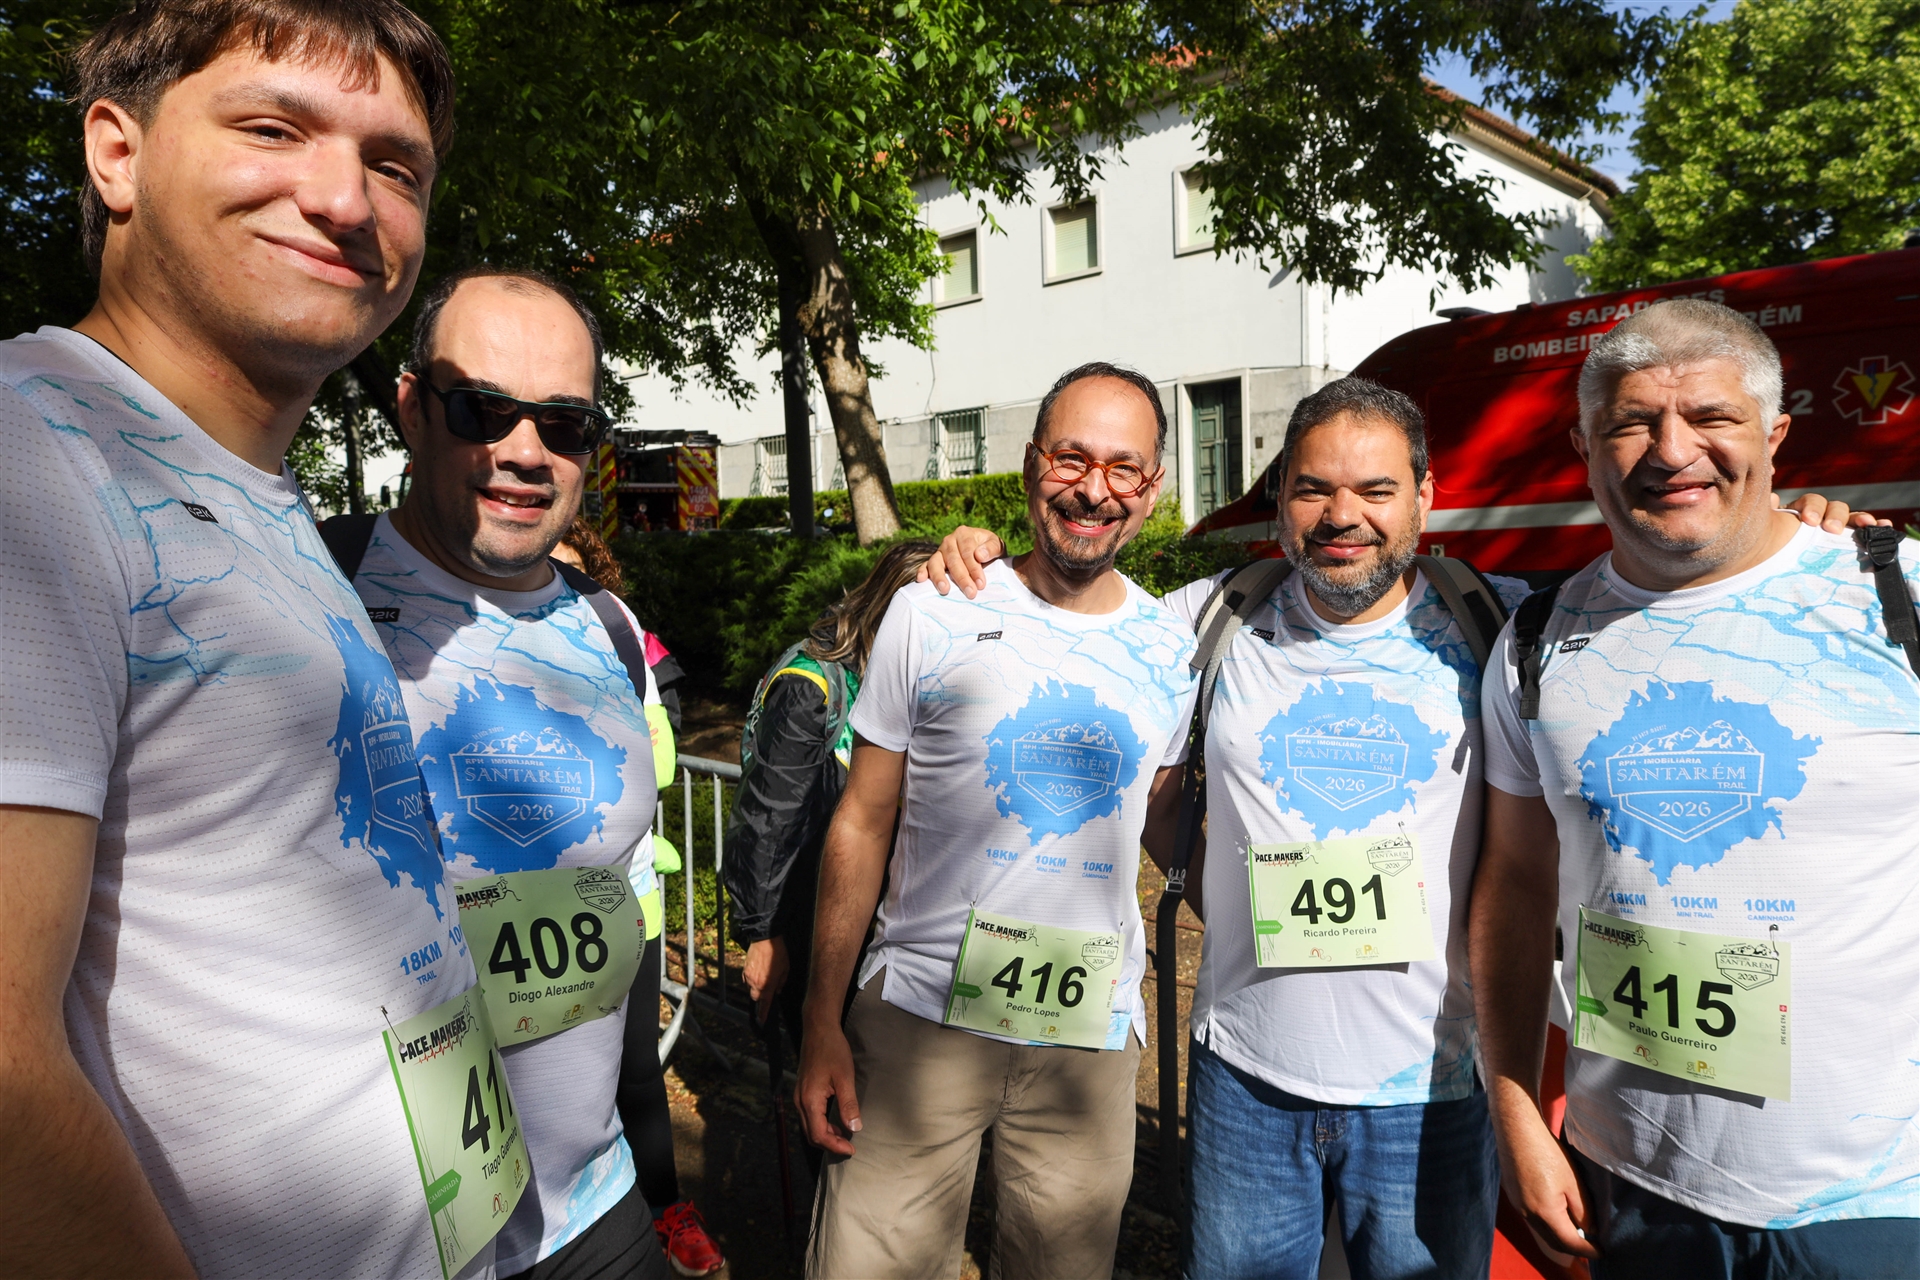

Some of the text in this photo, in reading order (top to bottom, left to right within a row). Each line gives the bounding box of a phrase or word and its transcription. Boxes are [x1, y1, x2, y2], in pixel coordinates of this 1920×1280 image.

[370, 737, 416, 773] SANTARÉ
[1020, 750, 1111, 773] SANTARÉM
[1294, 745, 1395, 765] SANTARÉM
[464, 766, 583, 785] SANTARÉM
[1090, 771, 1109, 779] TRAIL
[1372, 764, 1394, 772] TRAIL
[1616, 763, 1747, 782] SANTARÉM
[560, 785, 583, 794] TRAIL
[1045, 781, 1083, 798] 2026
[1325, 776, 1366, 792] 2026
[1717, 781, 1747, 789] TRAIL
[507, 803, 555, 821] 2026
[1658, 801, 1712, 817] 2026
[985, 848, 1019, 862] 18KM
[1034, 854, 1067, 868] 10KM
[1082, 861, 1114, 873] 10KM
[580, 884, 621, 894] SANTARÉM
[1290, 873, 1387, 925] 491
[1608, 891, 1647, 906] 18KM
[1670, 895, 1718, 909] 10KM
[1744, 898, 1796, 912] 10KM
[1619, 907, 1636, 915] TRAIL
[1694, 911, 1715, 919] TRAIL
[1747, 914, 1795, 922] CAMINHADA
[1303, 926, 1377, 938] Ricardo Pereira
[488, 911, 609, 984] 408
[400, 940, 443, 976] 18KM
[1719, 958, 1773, 970] SANTARÉM
[416, 970, 438, 986] TRAIL
[991, 956, 1088, 1009] 416
[509, 980, 595, 1004] Diogo Alexandre
[1613, 965, 1736, 1038] 415
[1006, 1002, 1061, 1018] Pedro Lopes
[1629, 1021, 1717, 1052] Paulo Guerreiro
[461, 1048, 514, 1154] 41
[481, 1155, 501, 1180] Tiago
[501, 1126, 519, 1160] Guerreiro
[428, 1177, 460, 1205] CAMINHADA
